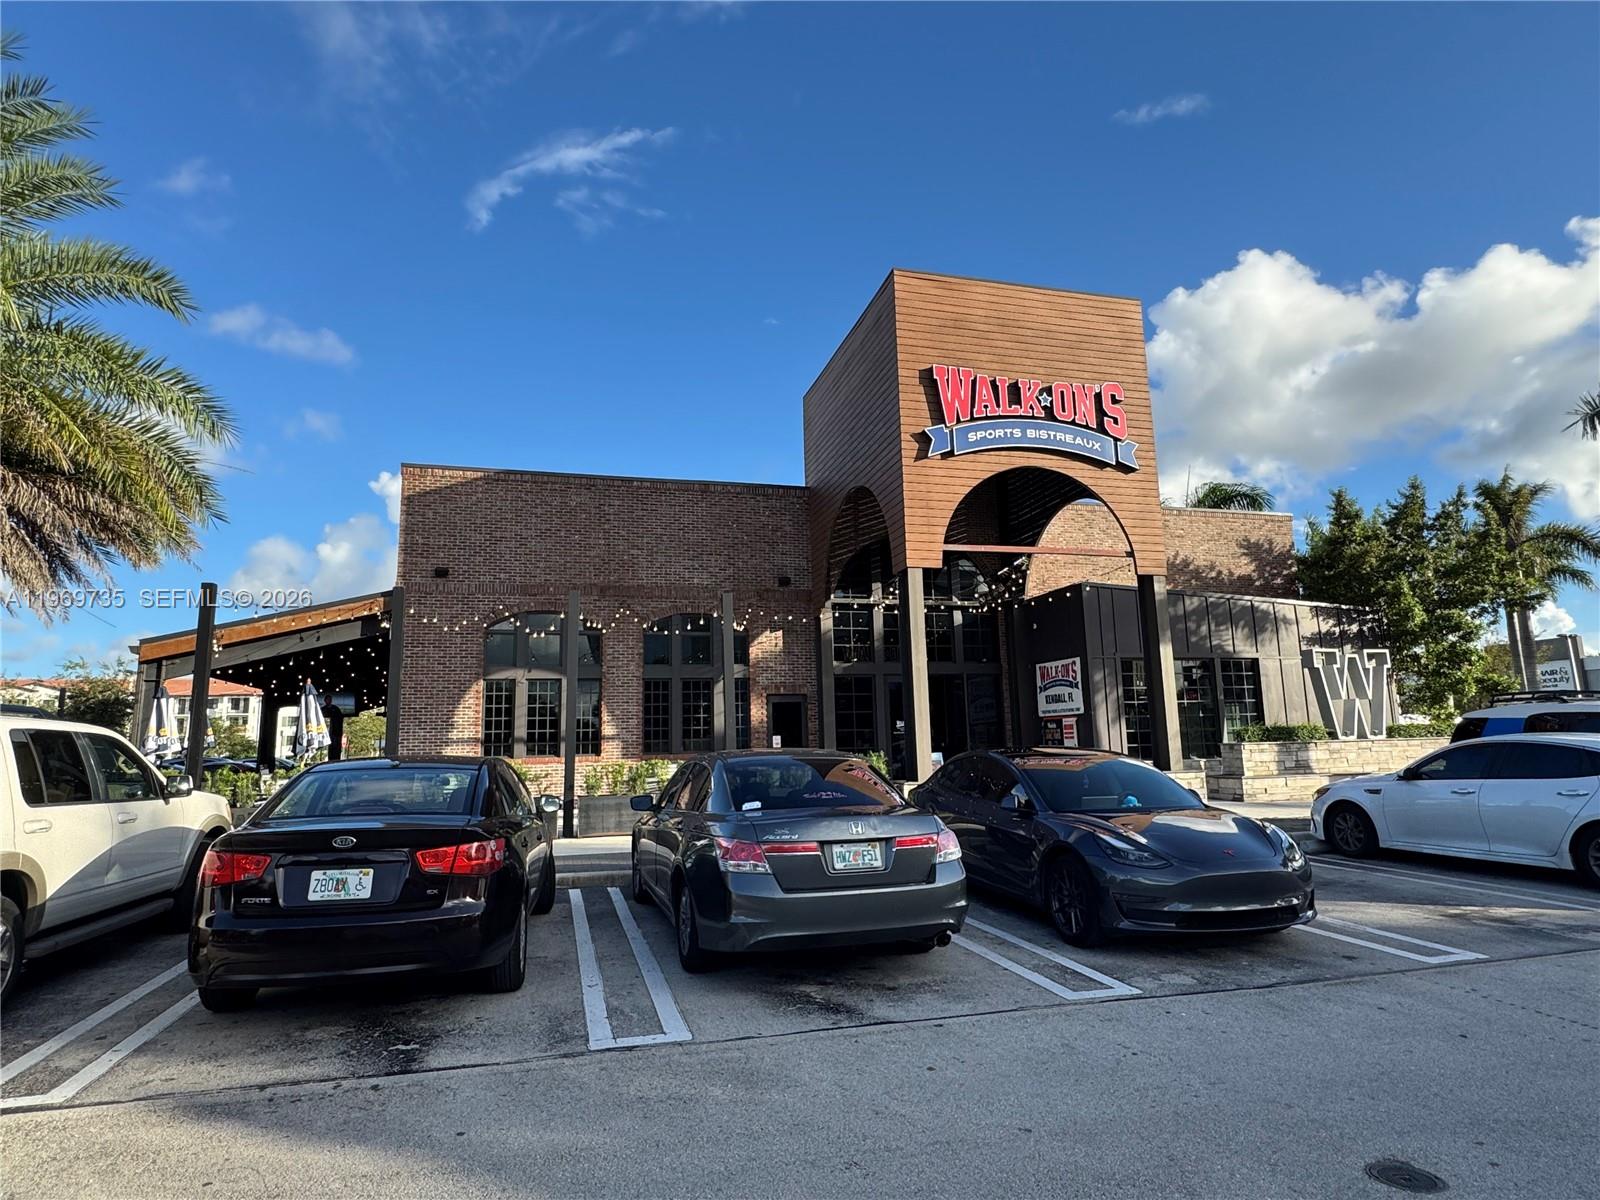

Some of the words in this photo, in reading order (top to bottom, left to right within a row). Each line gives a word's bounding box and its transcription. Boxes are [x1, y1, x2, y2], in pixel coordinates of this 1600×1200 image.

[967, 428, 1022, 442] SPORTS
[1026, 428, 1101, 451] BISTREAUX
[1312, 648, 1391, 739] W
